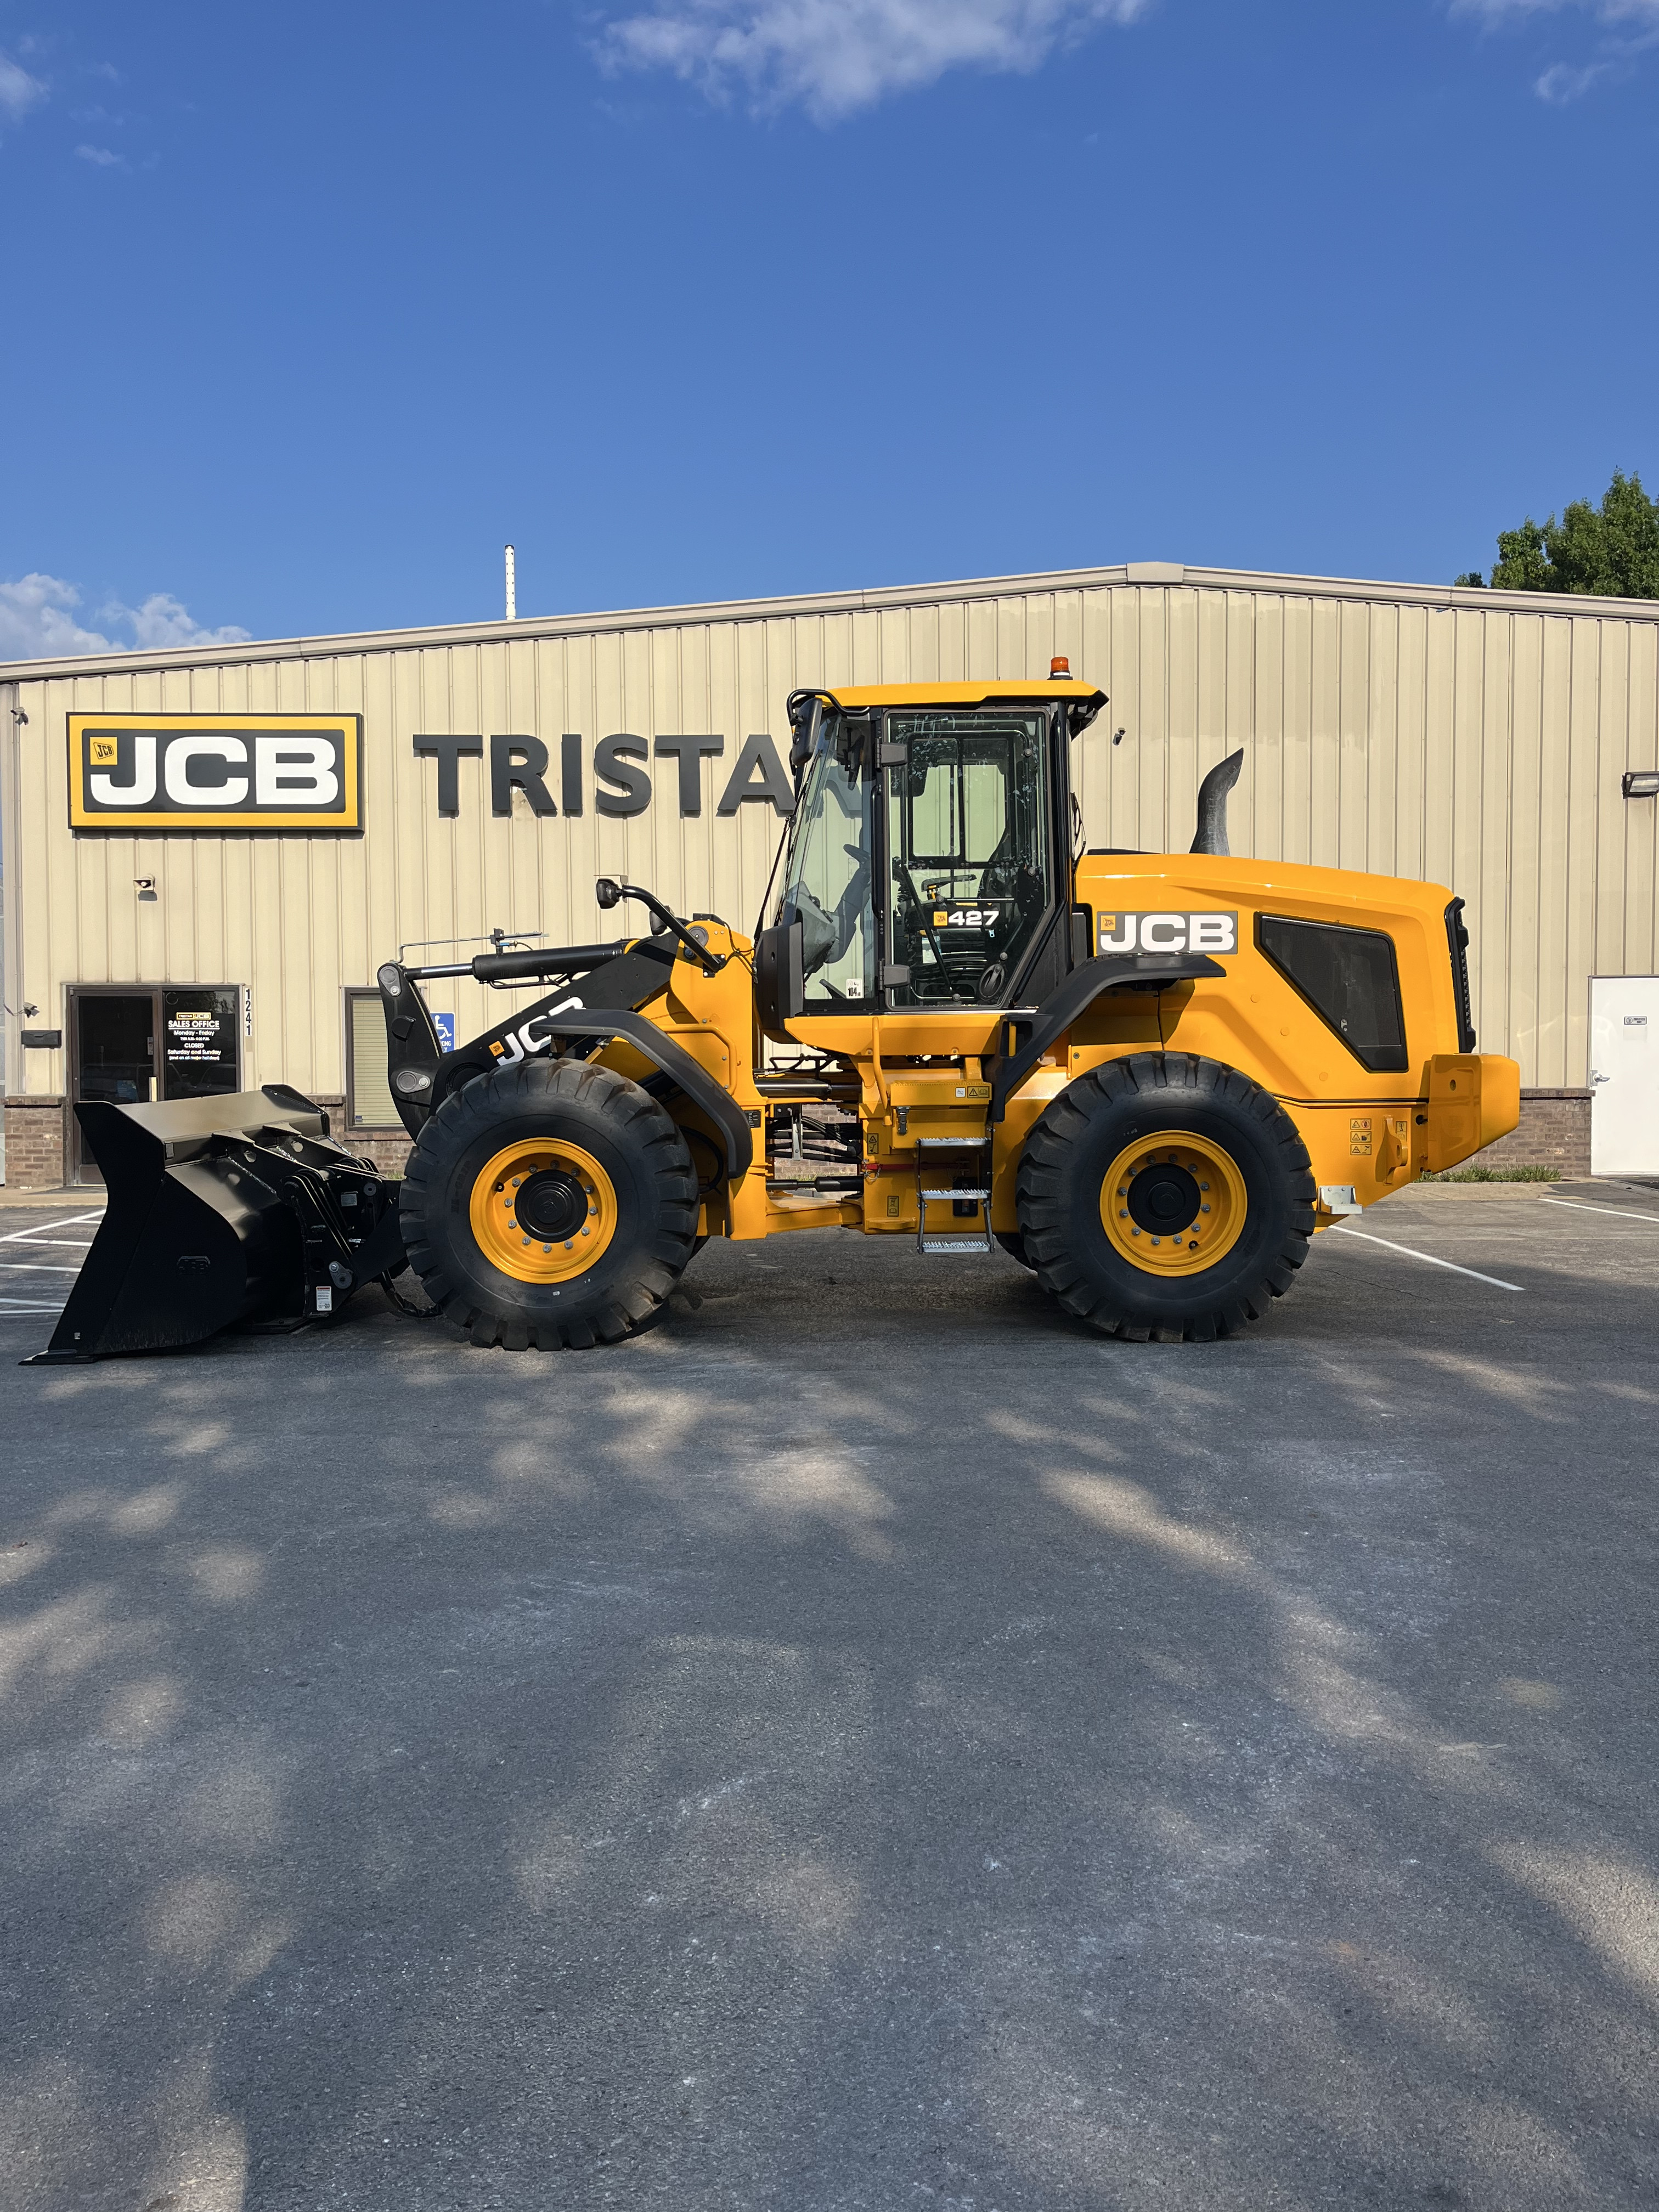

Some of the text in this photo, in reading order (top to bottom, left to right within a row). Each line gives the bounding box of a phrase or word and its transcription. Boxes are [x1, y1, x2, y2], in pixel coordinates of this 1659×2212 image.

[97, 744, 113, 758] JCB
[90, 736, 339, 805] JCB
[948, 911, 1000, 926] 427
[1100, 915, 1234, 951] JCB
[848, 987, 857, 997] 104
